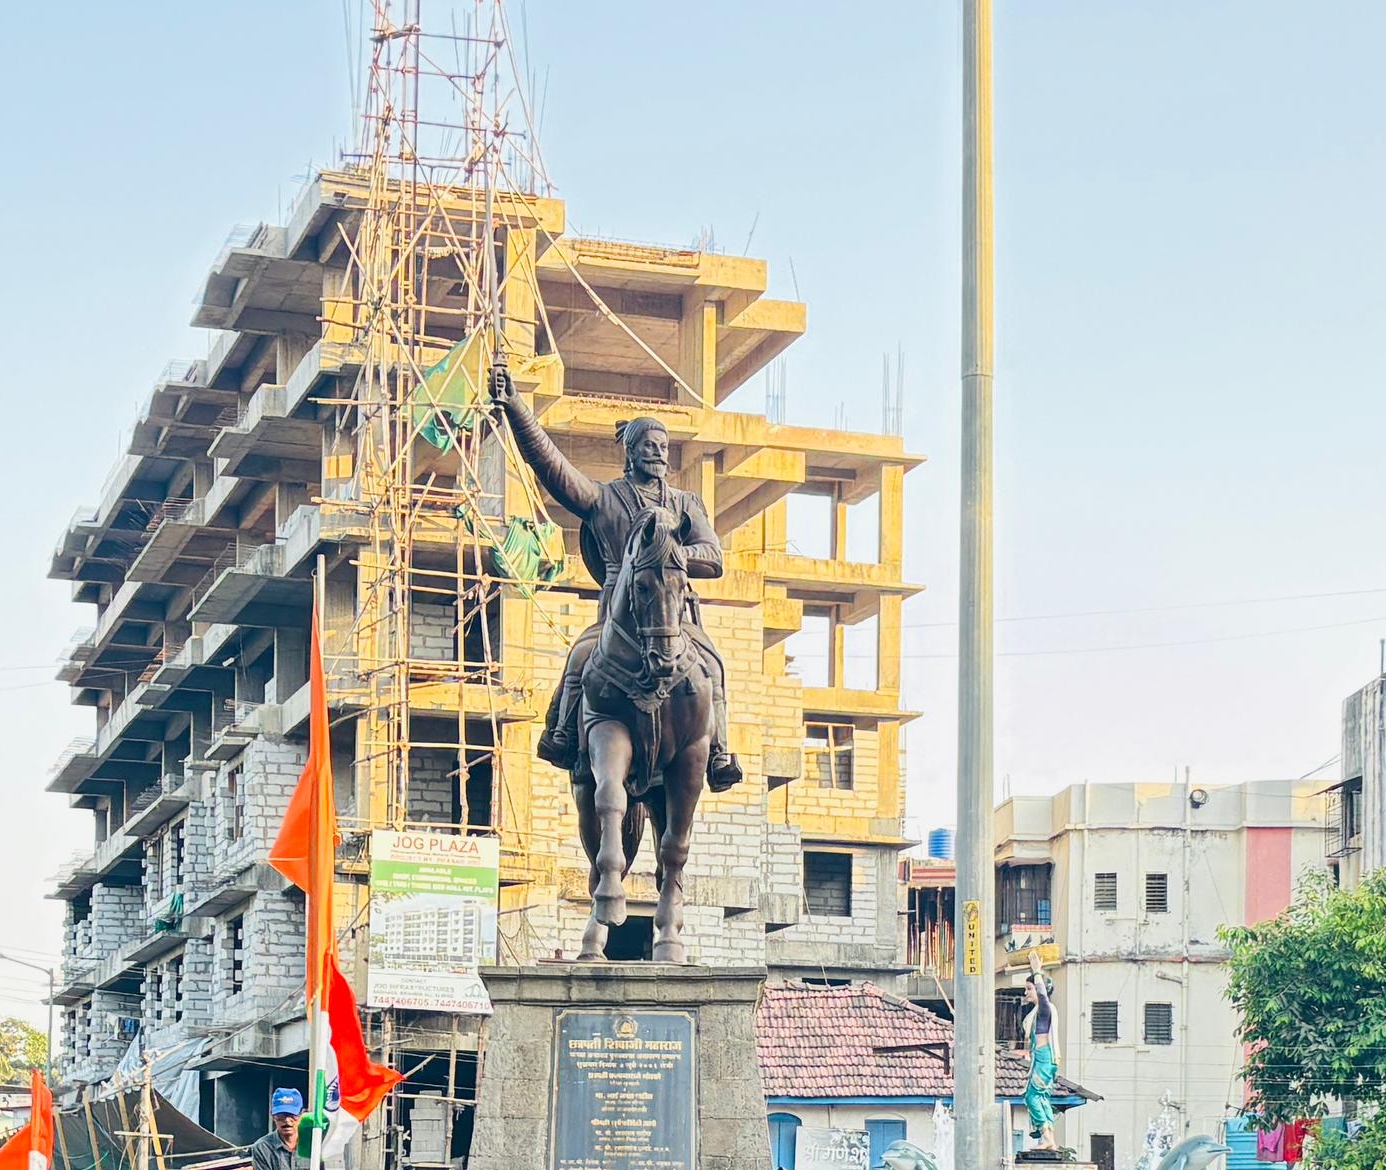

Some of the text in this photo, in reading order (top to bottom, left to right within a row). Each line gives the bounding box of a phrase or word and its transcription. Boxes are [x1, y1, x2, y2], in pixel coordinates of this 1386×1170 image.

[393, 836, 479, 854] JOG PLAZA
[569, 1036, 683, 1051] छत्रपती शिवाजी महाराज
